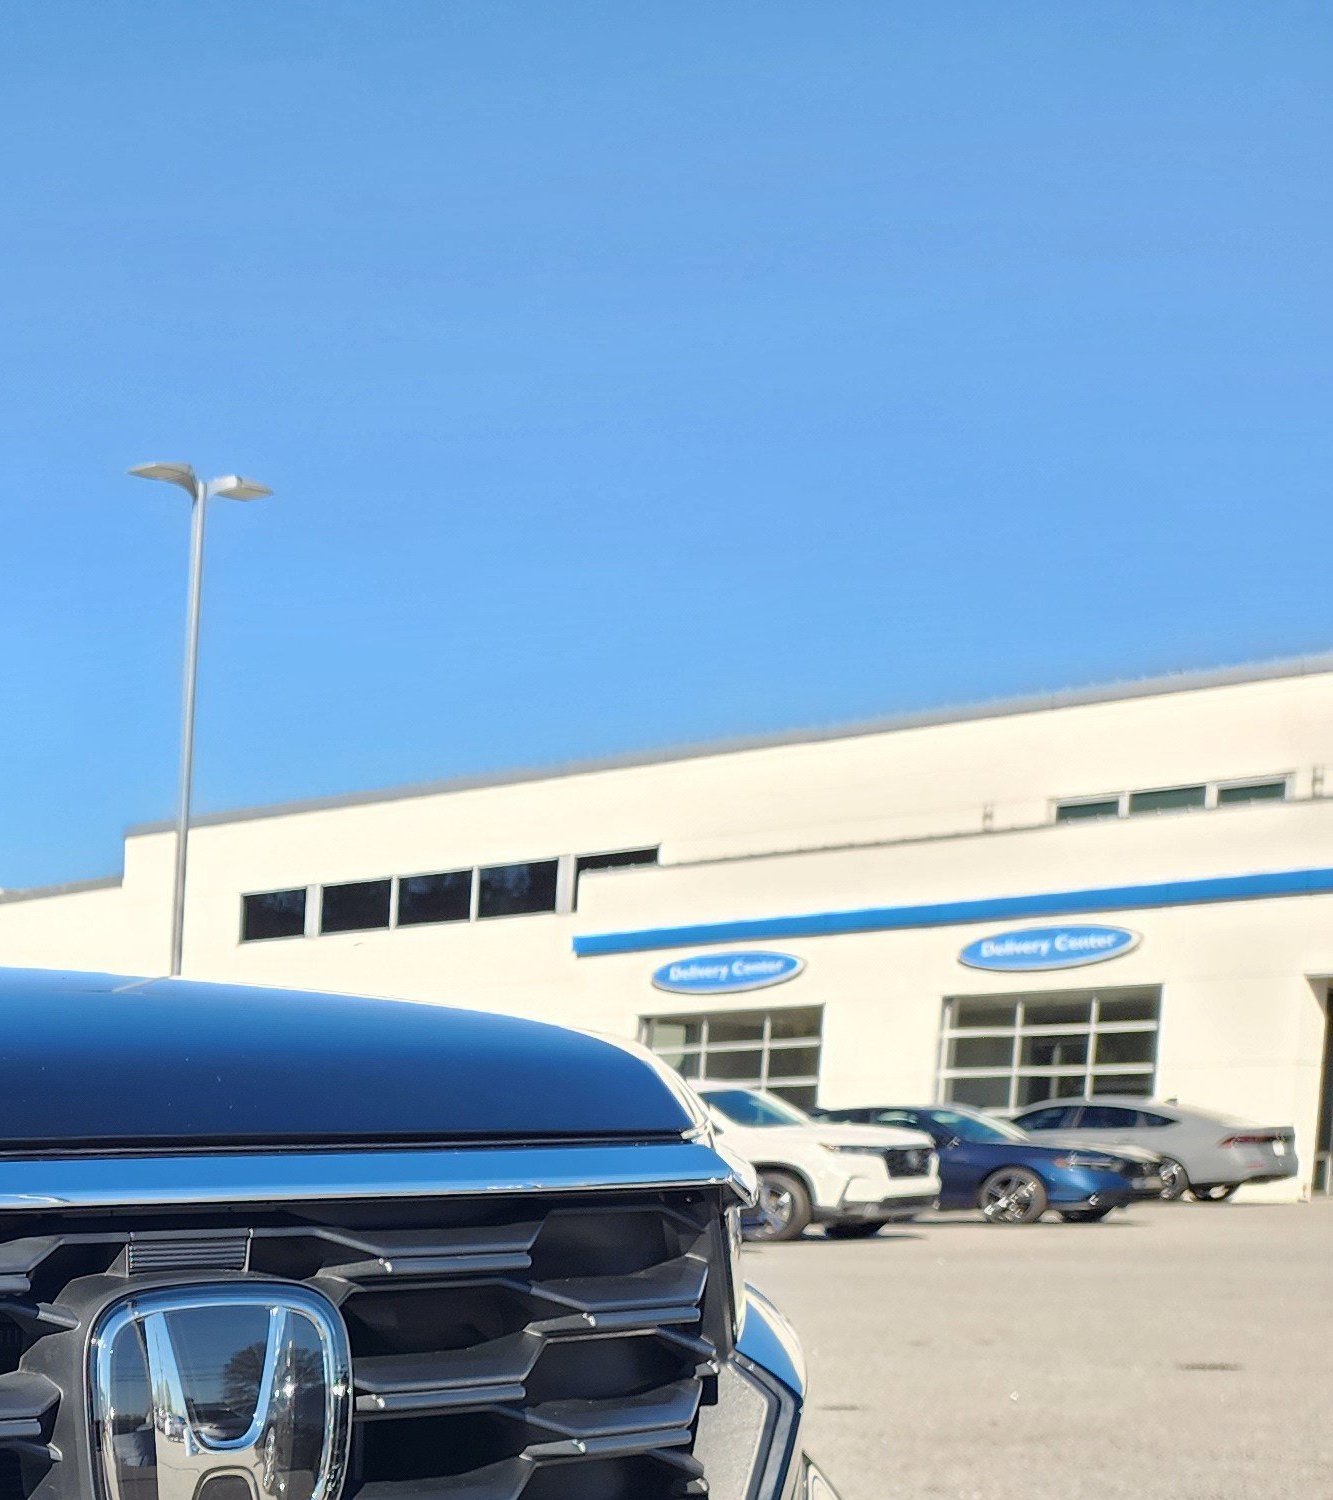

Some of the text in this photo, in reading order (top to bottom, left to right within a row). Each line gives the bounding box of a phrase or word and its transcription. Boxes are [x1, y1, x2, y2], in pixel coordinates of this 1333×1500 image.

[980, 933, 1116, 957] Delivery Center
[669, 960, 785, 982] Delivery Center
